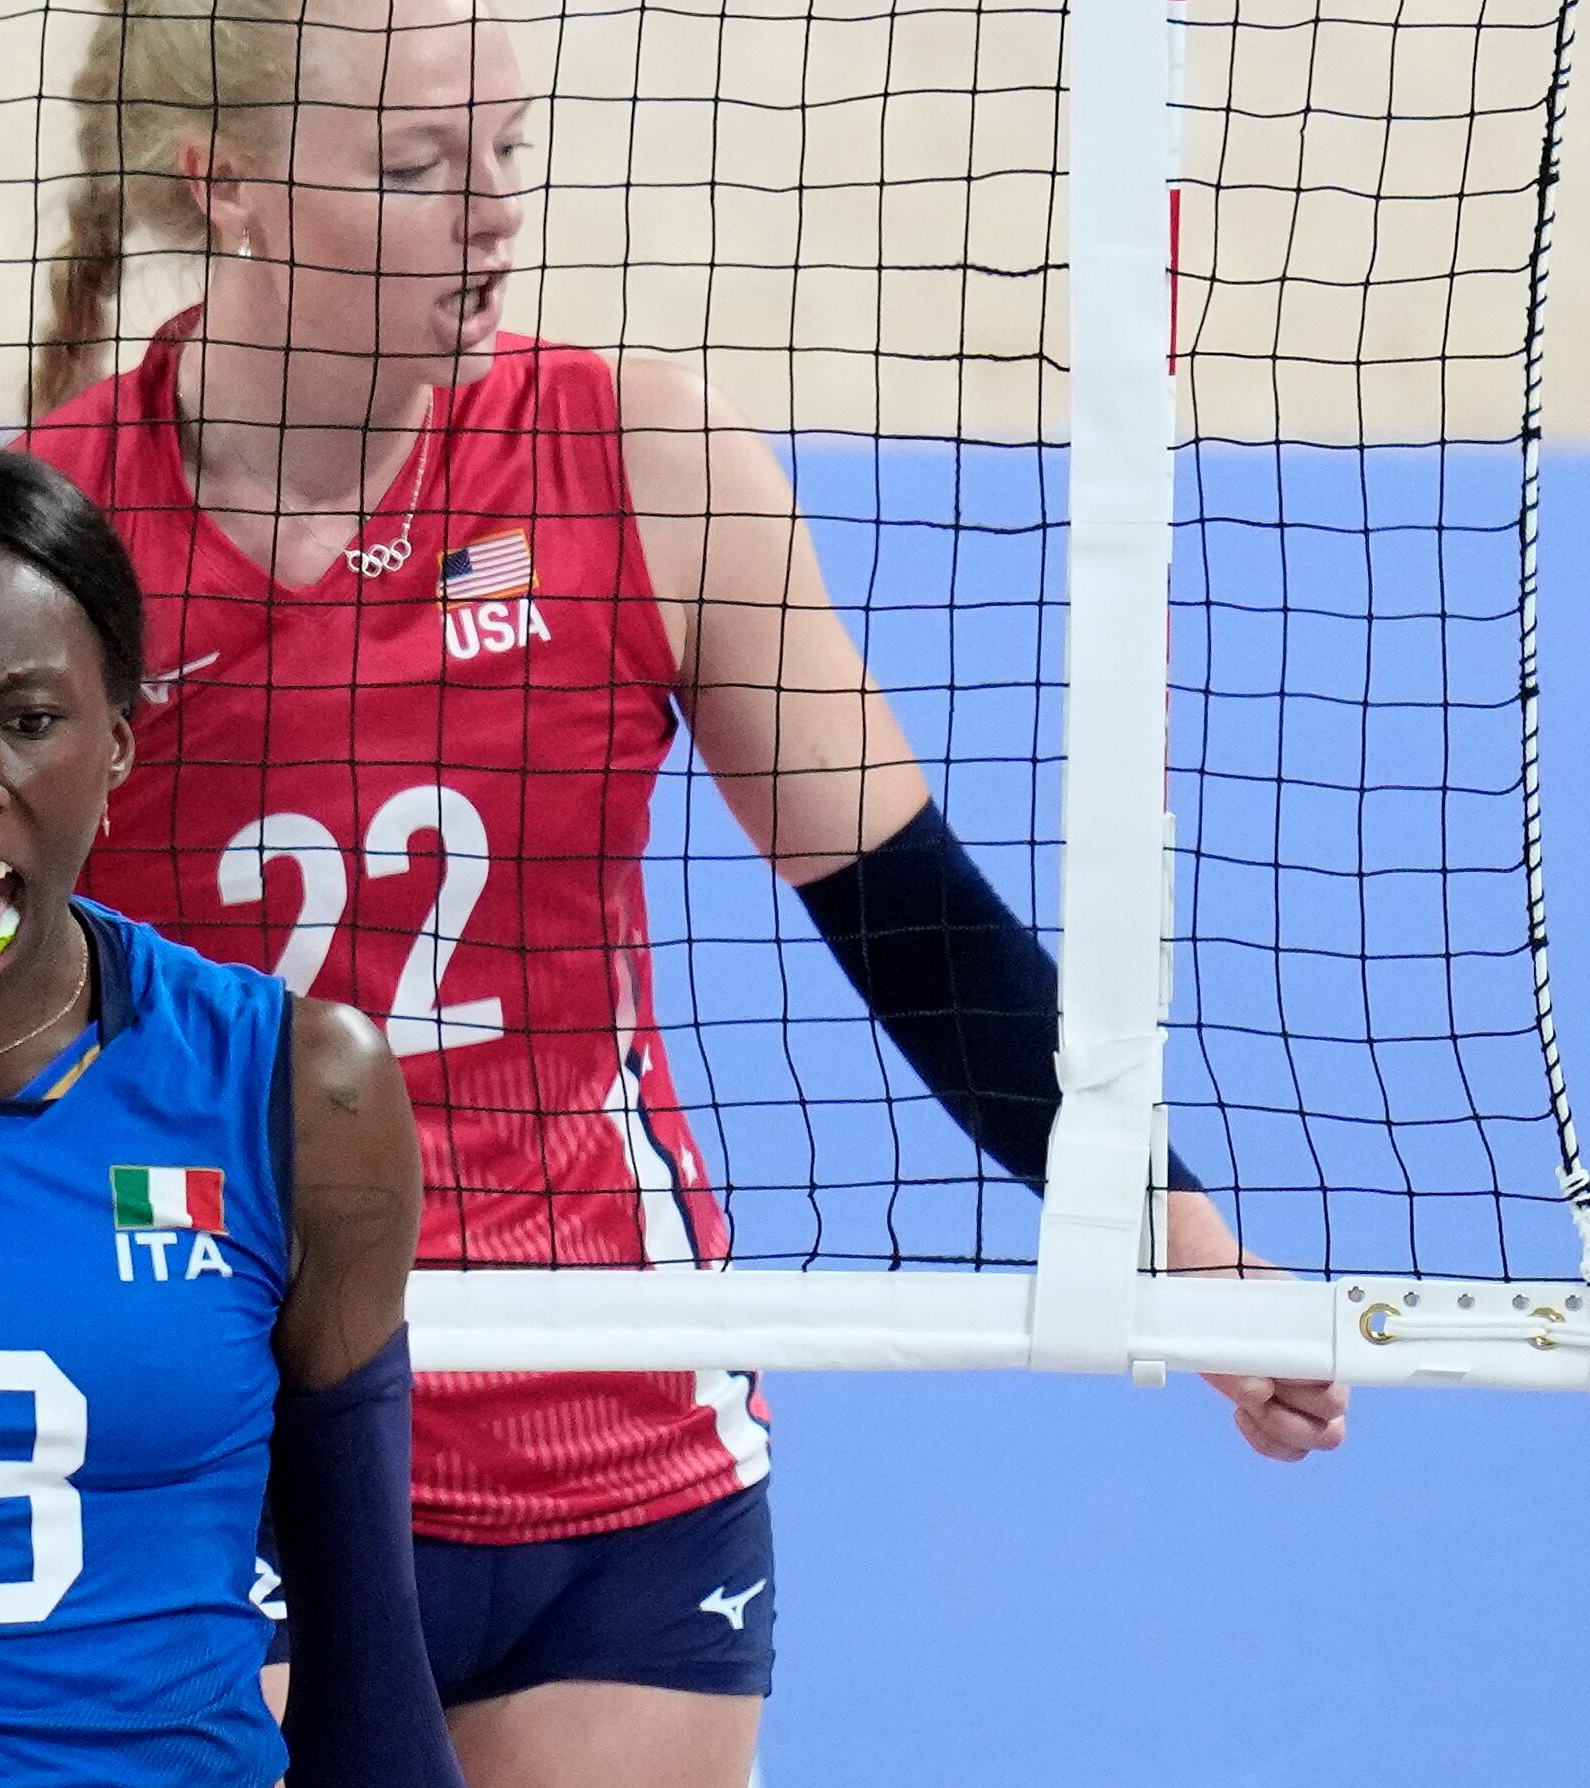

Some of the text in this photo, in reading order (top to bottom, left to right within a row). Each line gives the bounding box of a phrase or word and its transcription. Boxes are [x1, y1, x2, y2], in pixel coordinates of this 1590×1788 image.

[443, 600, 552, 660] USA
[217, 784, 504, 1058] 22
[115, 1231, 233, 1282] ITA
